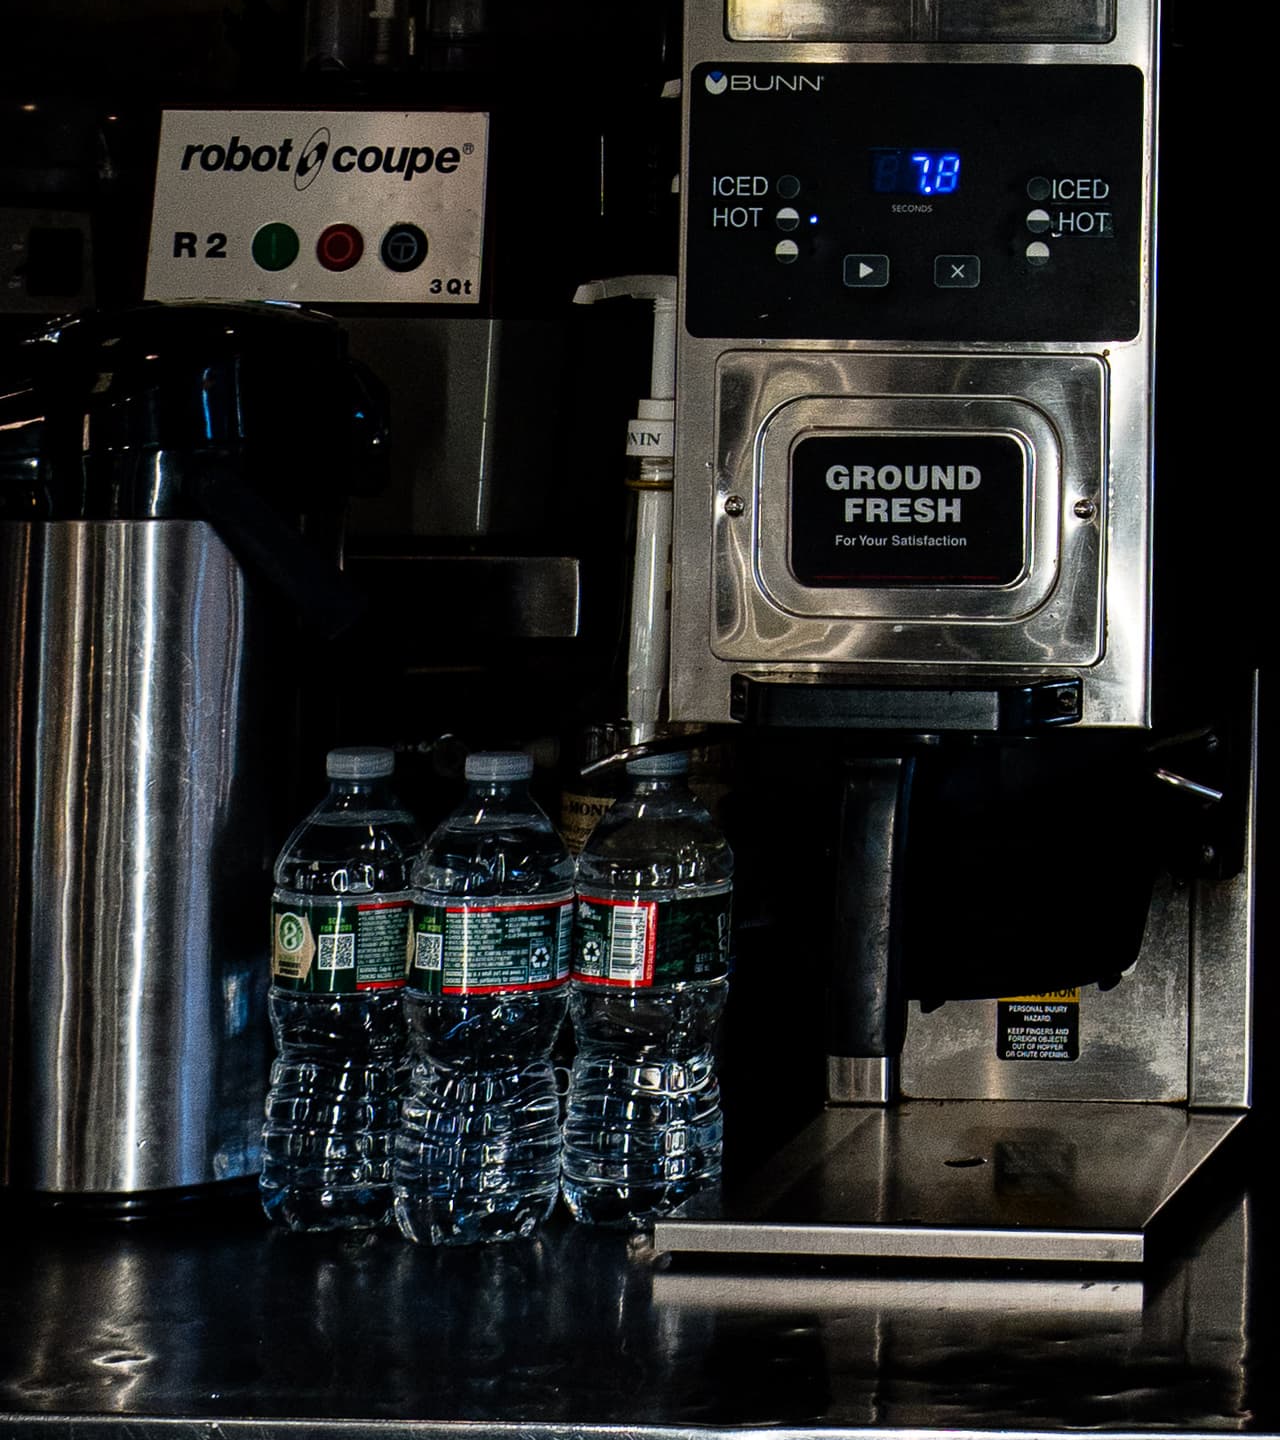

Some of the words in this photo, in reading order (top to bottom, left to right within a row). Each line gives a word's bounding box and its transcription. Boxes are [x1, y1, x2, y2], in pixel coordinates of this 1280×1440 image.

[729, 73, 824, 93] BUNN
[181, 136, 293, 171] robot
[332, 145, 461, 180] coupe
[711, 175, 769, 198] ICED
[1050, 178, 1111, 200] ICED
[711, 207, 763, 229] HOT
[890, 203, 933, 213] SECONDS
[1057, 211, 1109, 233] HOT
[173, 232, 197, 258] R
[206, 232, 228, 258] 2
[824, 464, 982, 491] GROUND
[844, 497, 962, 524] FRESH
[834, 534, 857, 547] For
[859, 535, 888, 547] Your
[891, 534, 967, 547] Satisfaction
[1008, 1005, 1043, 1013] PERSONAL
[1007, 1027, 1024, 1035] KEEP
[1026, 1027, 1054, 1035] FINGERS
[1055, 1027, 1070, 1035] AND
